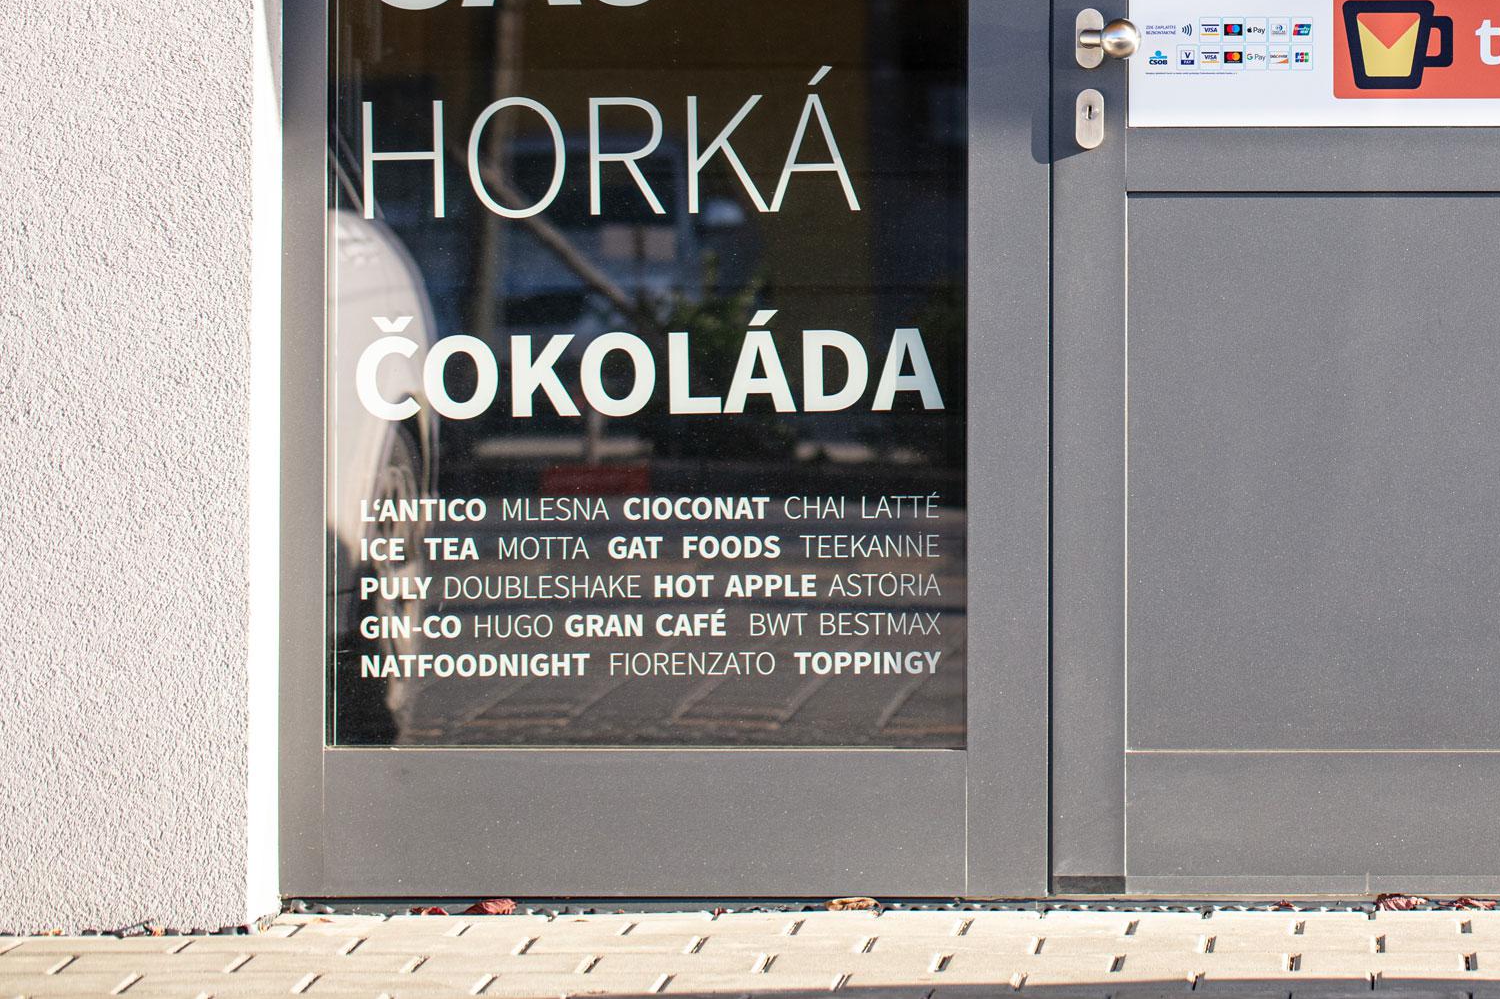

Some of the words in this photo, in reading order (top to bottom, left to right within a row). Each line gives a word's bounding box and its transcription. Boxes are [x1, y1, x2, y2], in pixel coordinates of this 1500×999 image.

[1253, 26, 1266, 35] Pay
[361, 65, 860, 221] HORKÁ
[355, 309, 946, 420] ČOKOLÁDA
[502, 497, 610, 521] MLESNA
[623, 497, 770, 521] CIOCONAT
[784, 495, 845, 520] CHAI
[861, 492, 940, 519] LATTÉ
[360, 537, 405, 561] ICE
[424, 537, 480, 561] TEA
[498, 536, 590, 560] MOTTA
[607, 536, 664, 560] GAT
[682, 535, 781, 559] FOODS
[800, 534, 940, 558] TEEKANNE
[360, 576, 433, 601] PULY
[444, 575, 641, 600] DOUBLESHAKE
[654, 574, 715, 598] HOT
[724, 574, 817, 598] APPLE
[828, 572, 941, 597] ASTORIA
[360, 615, 462, 640] GIN-CO
[474, 614, 553, 639] HUGO
[564, 614, 643, 638] GRAN
[655, 608, 727, 637] CAFÉ
[750, 612, 808, 636] BWT
[820, 612, 941, 636] BESTMAX
[361, 653, 591, 678] NATFOODNIGHT
[610, 651, 776, 676] FIORENZATO
[793, 651, 941, 675] TOPPINGY
